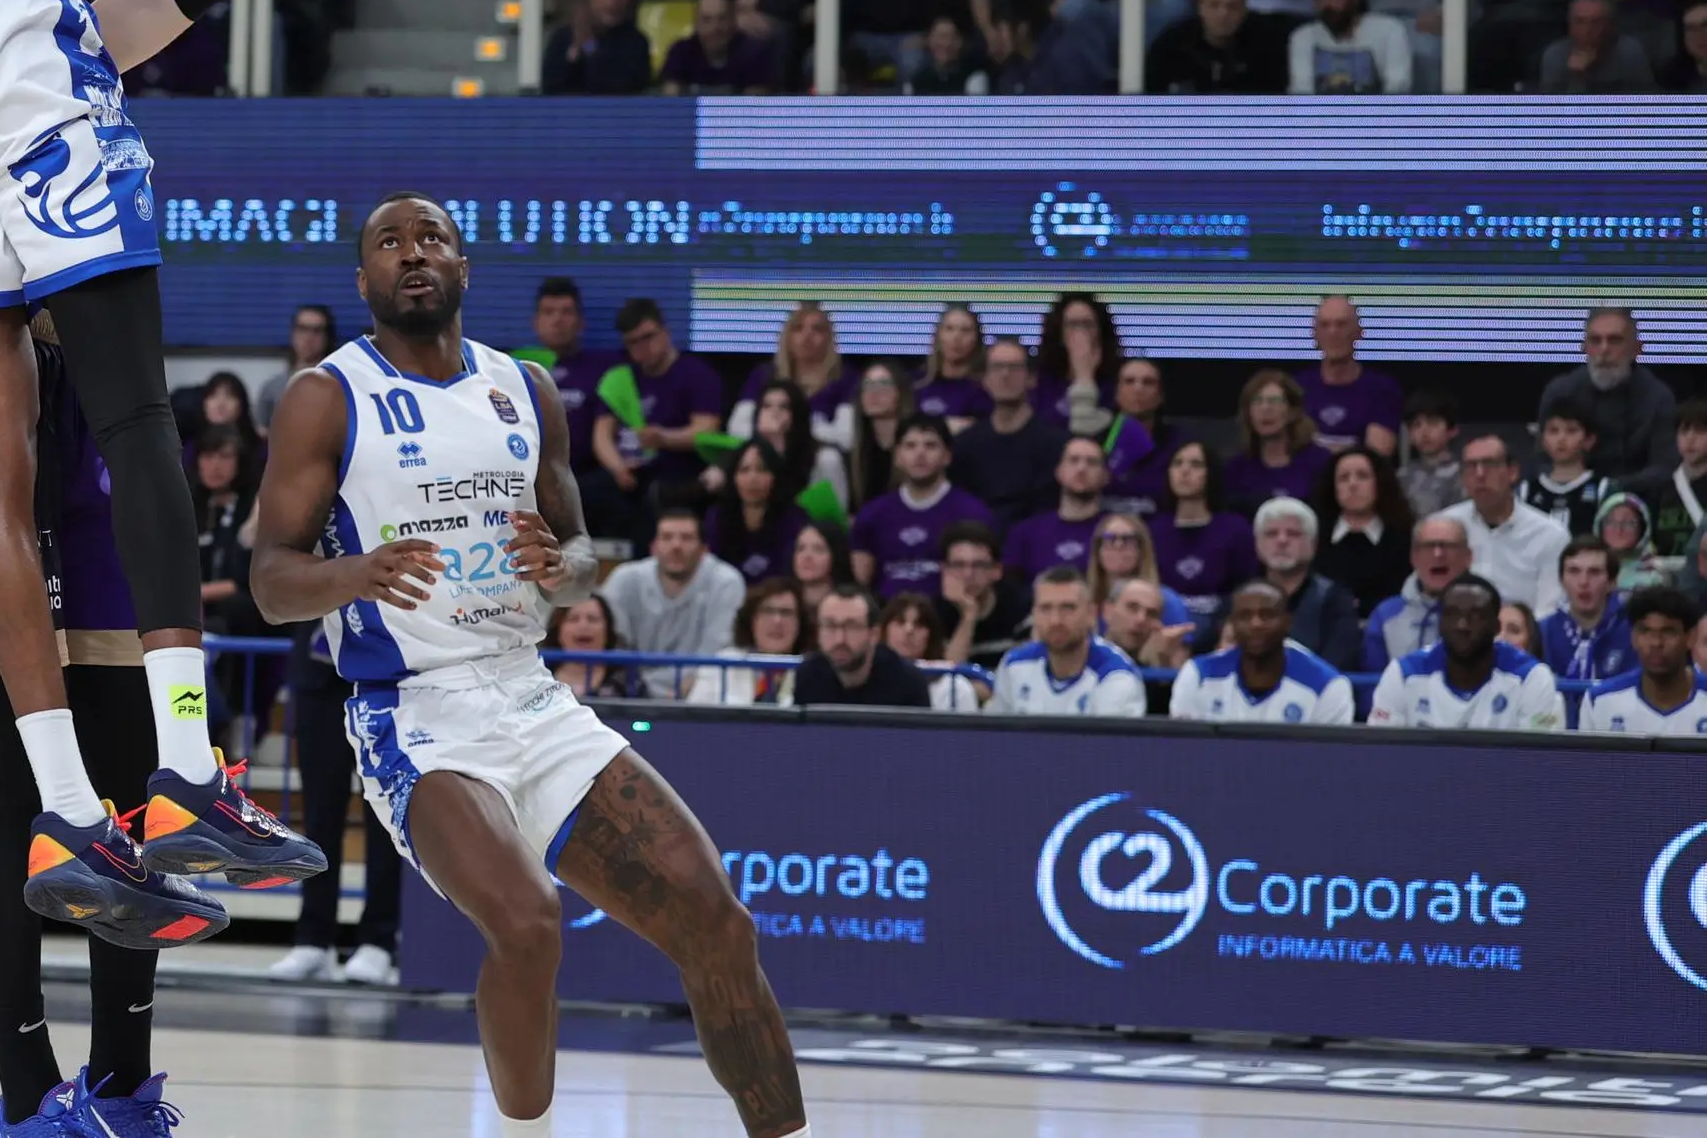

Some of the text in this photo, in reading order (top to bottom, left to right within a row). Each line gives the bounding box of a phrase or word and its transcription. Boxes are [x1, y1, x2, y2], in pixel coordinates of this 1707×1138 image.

[370, 388, 425, 434] 10
[417, 479, 525, 503] TECHNE
[1217, 858, 1526, 930] Corporate
[1218, 933, 1392, 963] INFORMATICA
